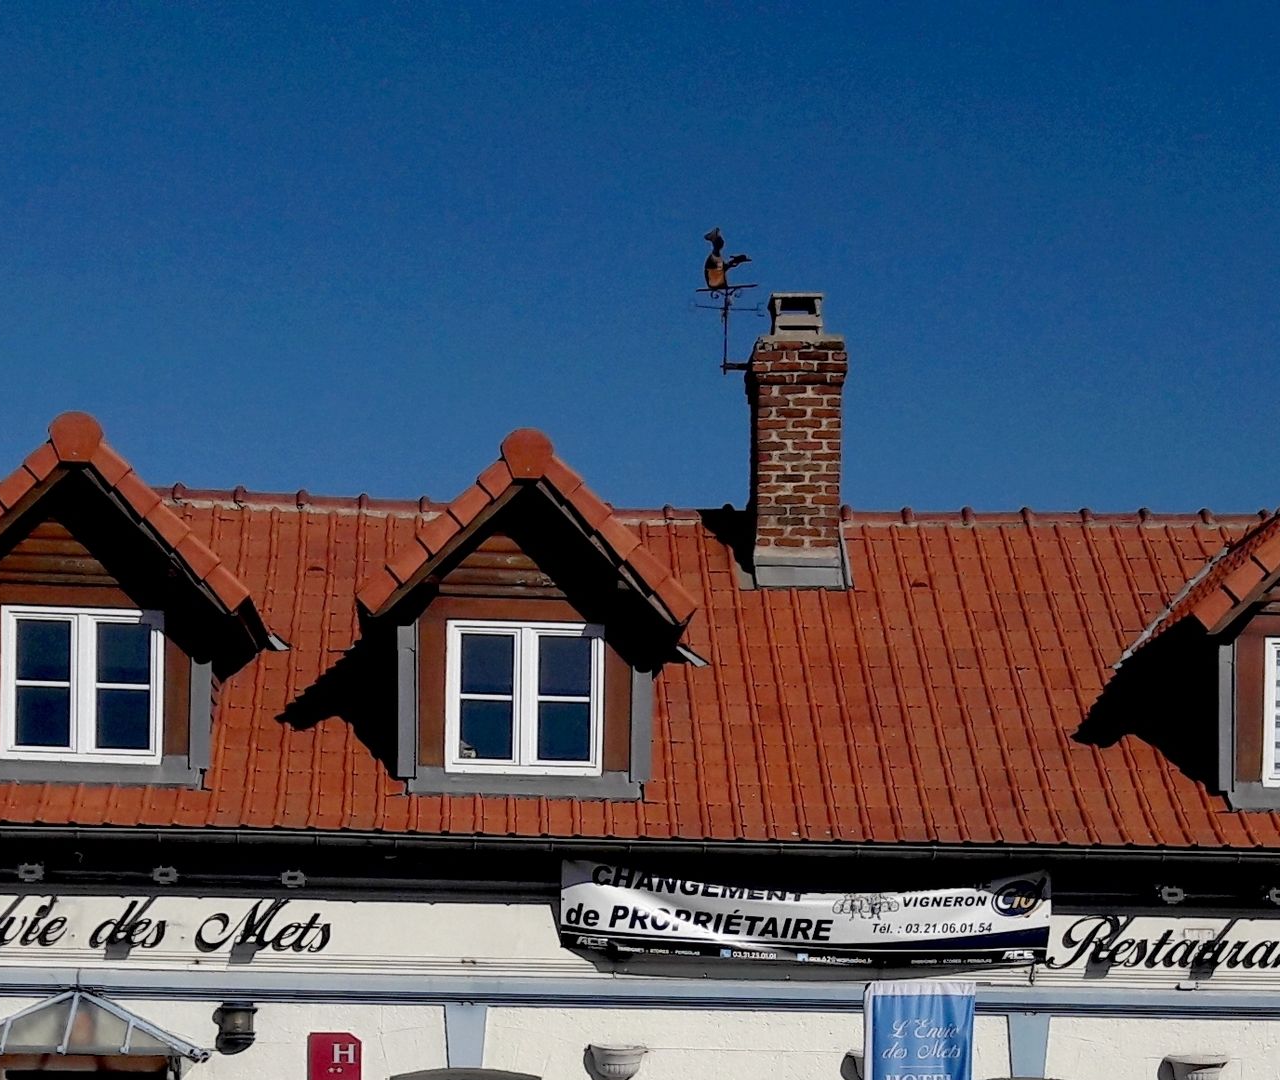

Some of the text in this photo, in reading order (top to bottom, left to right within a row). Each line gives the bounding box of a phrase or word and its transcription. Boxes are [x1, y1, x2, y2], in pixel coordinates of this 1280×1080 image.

[592, 865, 804, 902] CHANGEMENT
[902, 896, 987, 907] VIGNERON
[89, 900, 167, 948] des
[195, 899, 331, 952] Mets
[566, 903, 834, 941] de PROPRIÉTAIRE
[872, 923, 893, 933] Tél.
[905, 923, 993, 933] 03.21.06.01.54
[1001, 950, 1035, 960] ACE
[332, 1042, 356, 1064] H
[882, 1040, 961, 1059] des Mets
